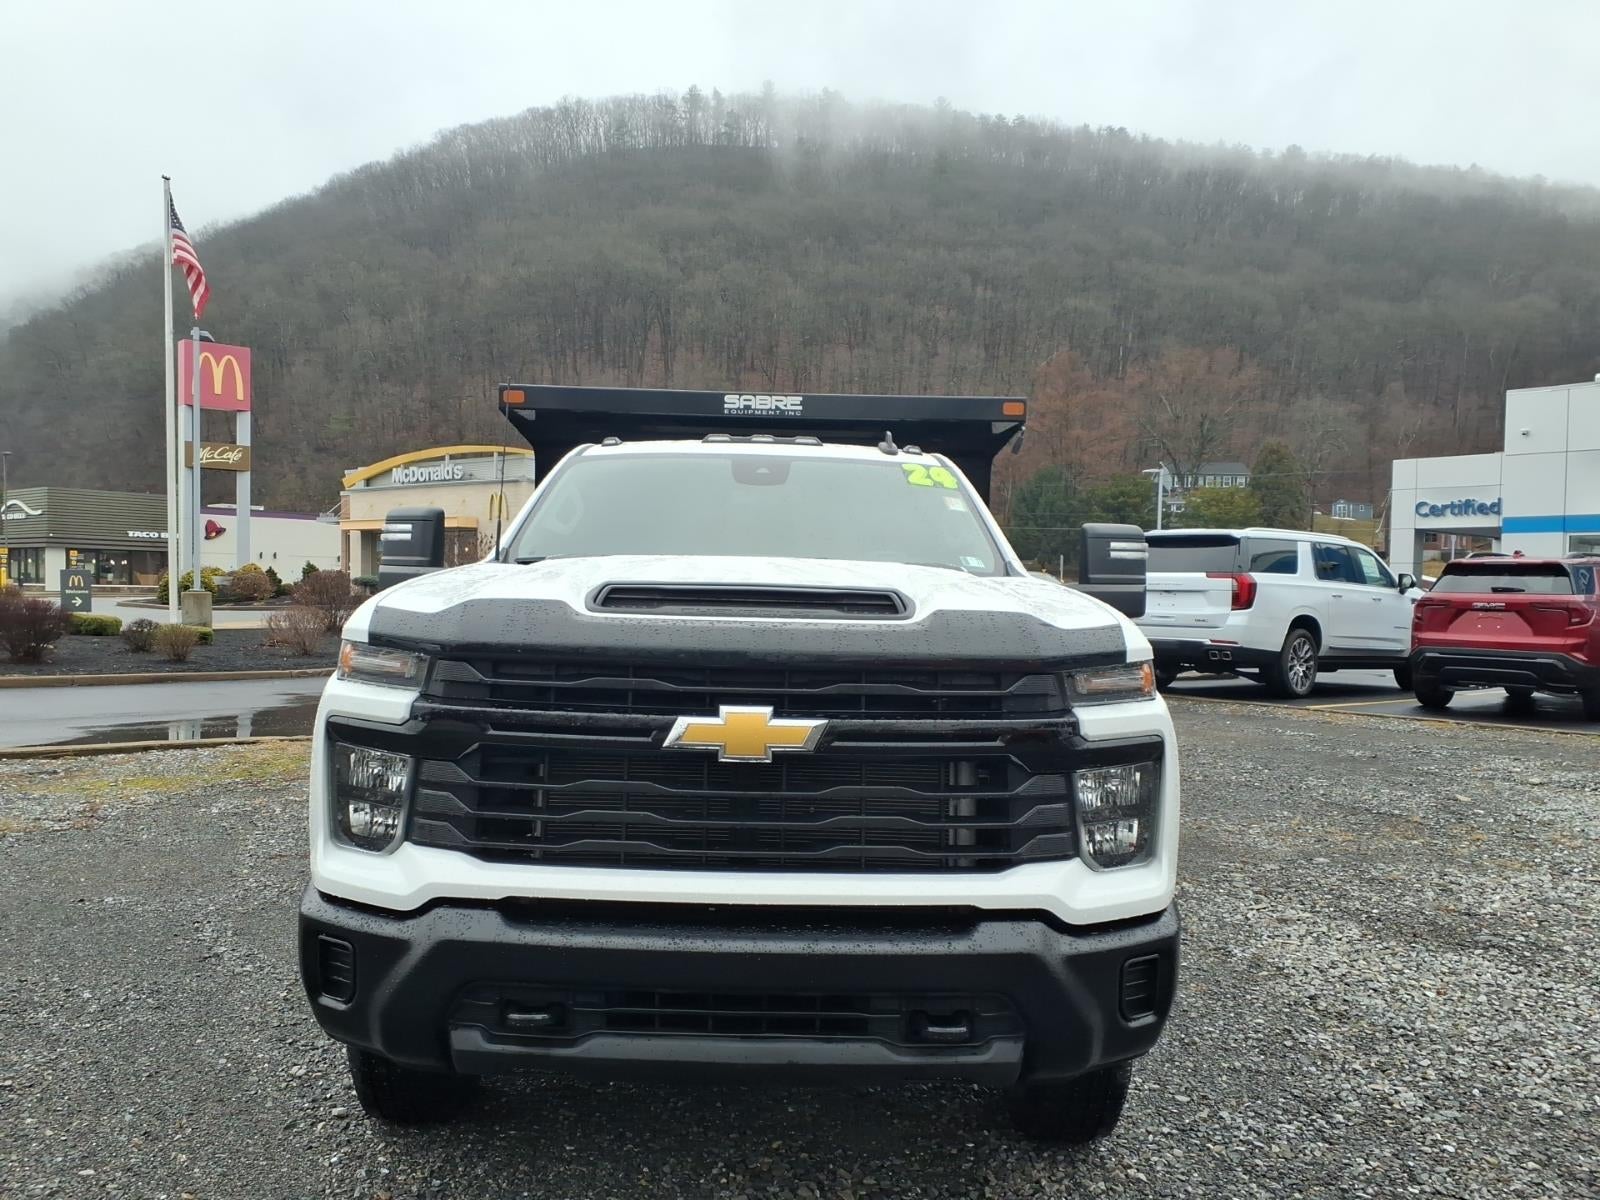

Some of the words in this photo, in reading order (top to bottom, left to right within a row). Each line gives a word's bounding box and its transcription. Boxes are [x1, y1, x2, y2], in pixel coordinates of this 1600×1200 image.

[724, 394, 803, 410] SABRE
[392, 464, 463, 483] McDonald's
[1415, 497, 1502, 518] Certified
[127, 530, 159, 539] TACO
